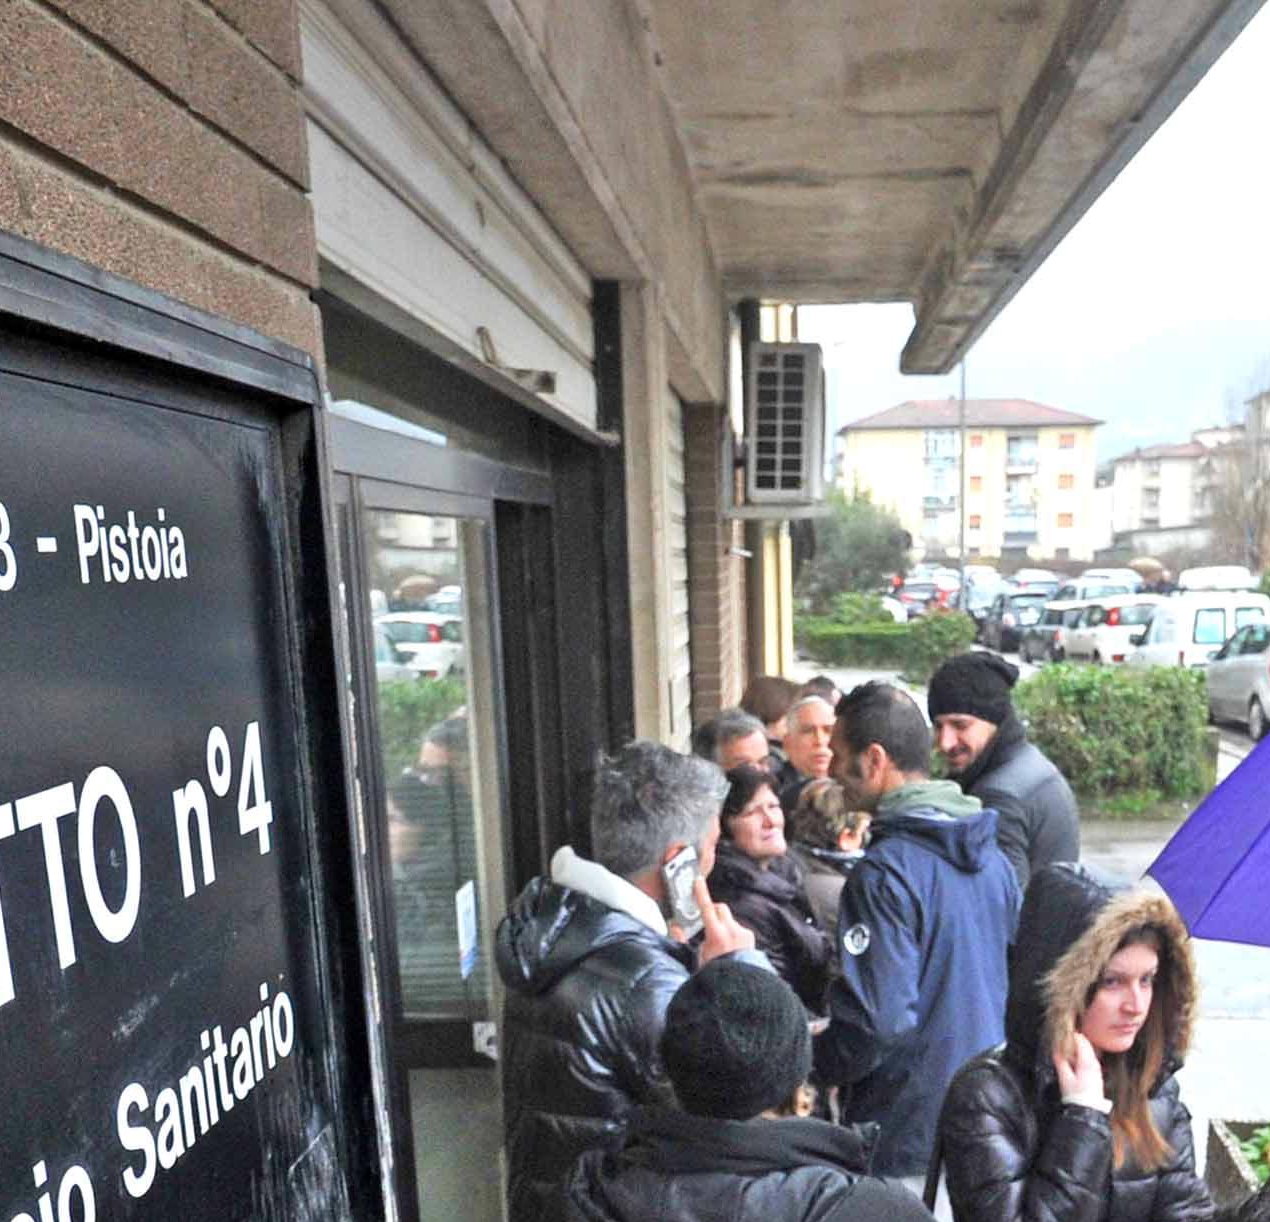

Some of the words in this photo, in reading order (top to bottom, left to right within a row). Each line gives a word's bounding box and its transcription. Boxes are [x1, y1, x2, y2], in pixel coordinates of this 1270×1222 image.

[36, 537, 58, 553] -
[73, 504, 188, 584] Pistoia
[116, 982, 294, 1198] Sanitario
